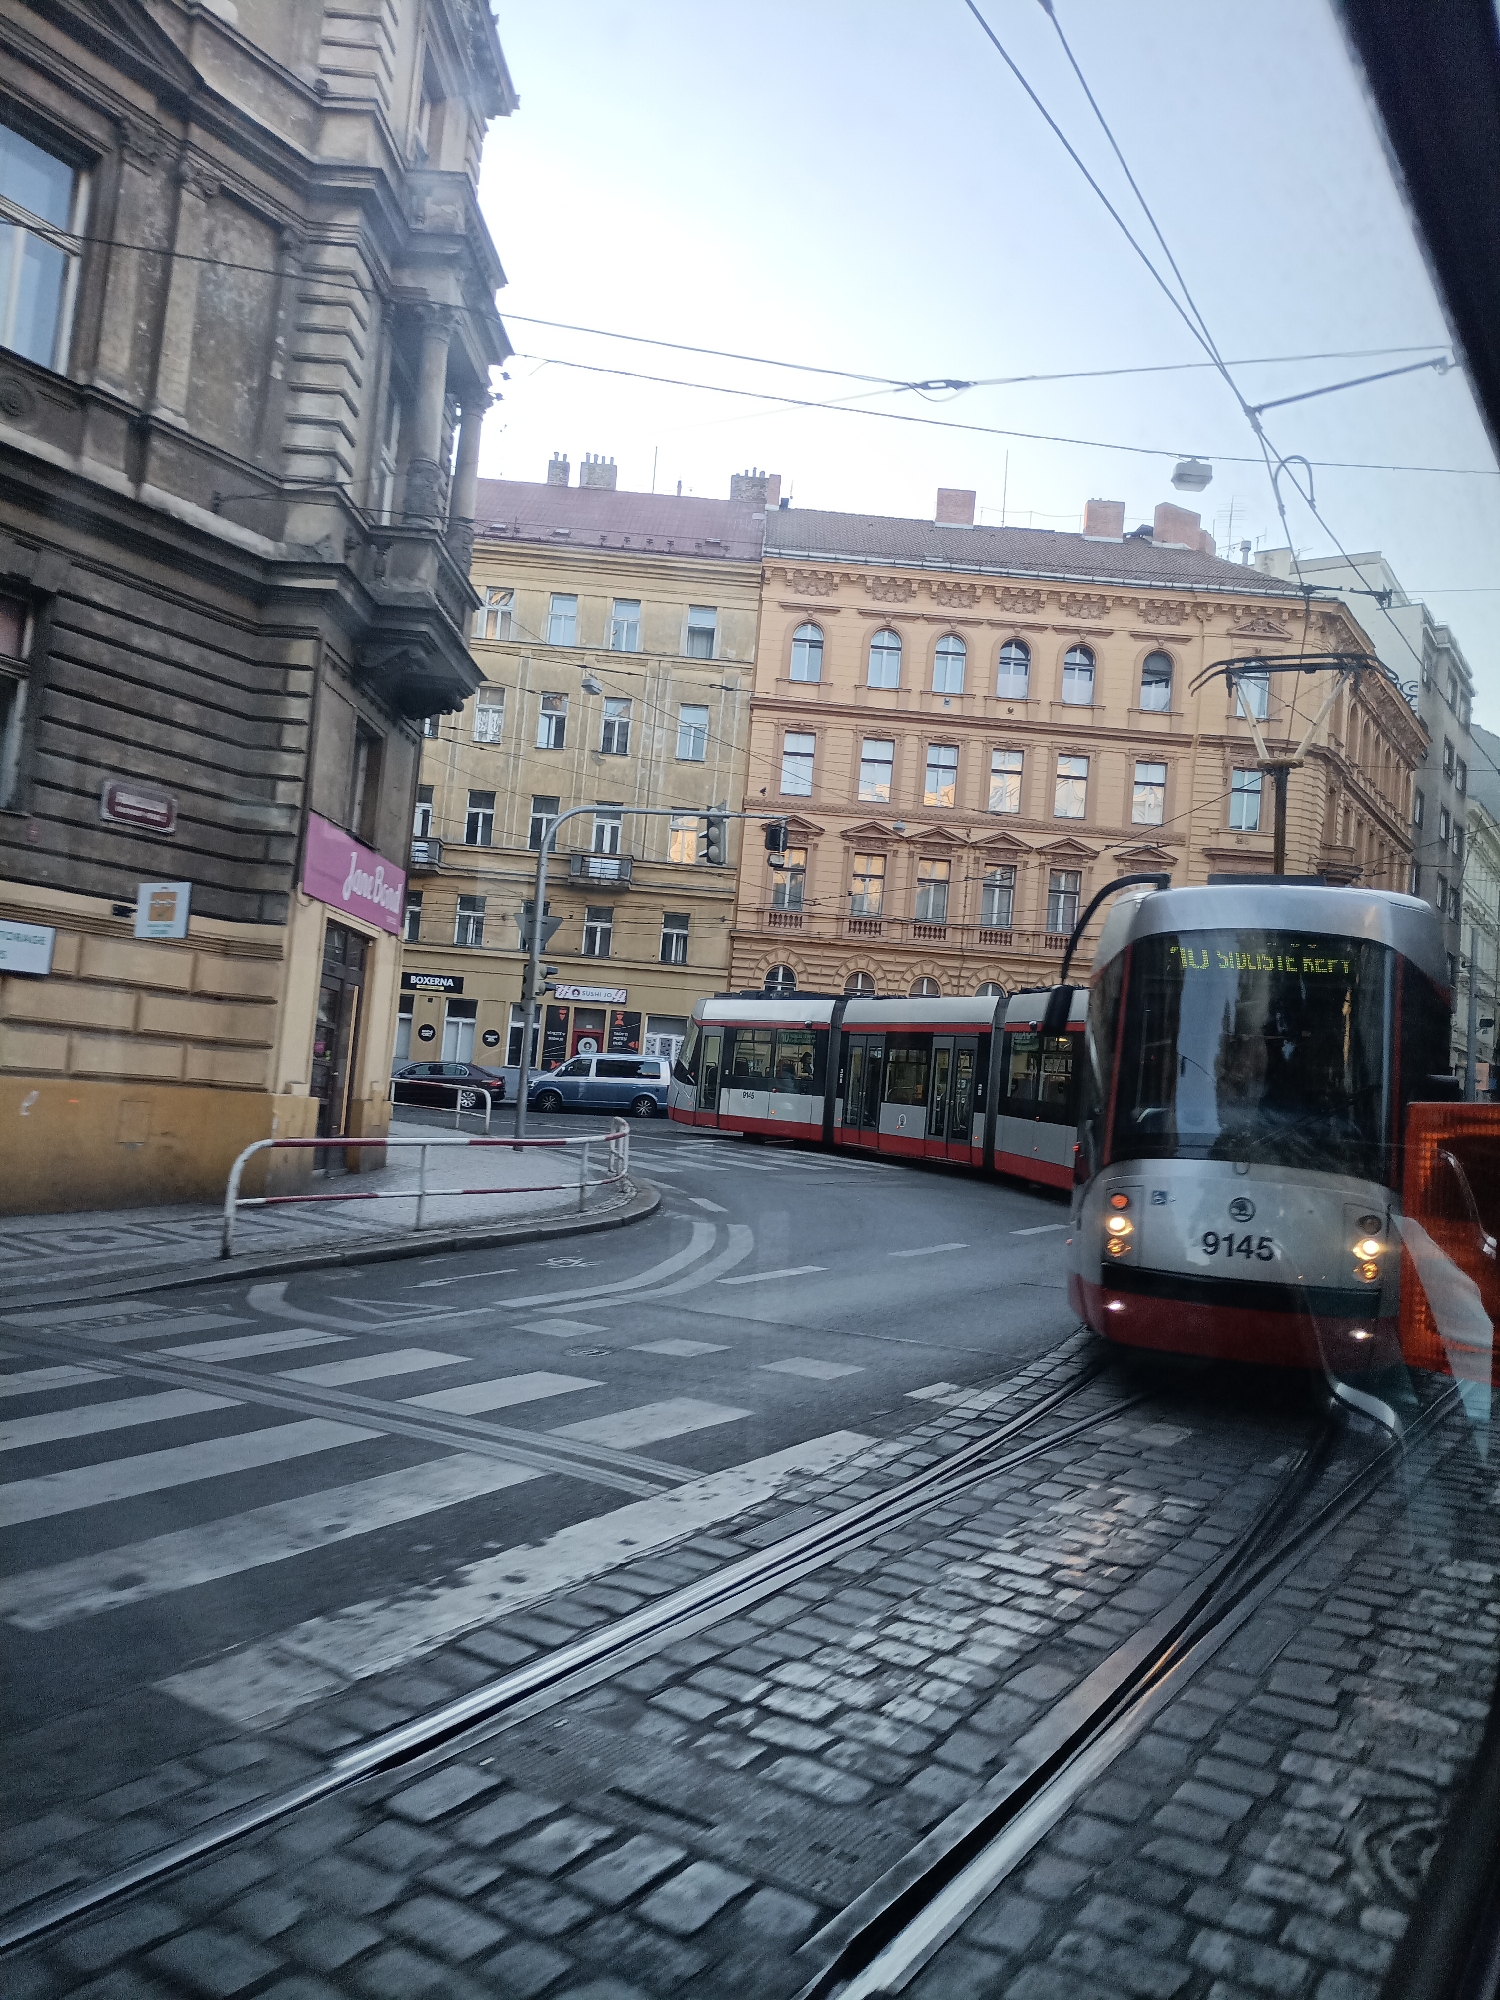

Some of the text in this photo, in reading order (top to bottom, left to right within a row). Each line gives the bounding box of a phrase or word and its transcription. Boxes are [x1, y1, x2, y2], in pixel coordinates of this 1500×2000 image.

[410, 975, 455, 987] BOXERNA
[582, 990, 602, 998] SUSHI
[742, 1090, 755, 1100] 9145
[1202, 1231, 1275, 1262] 9145
